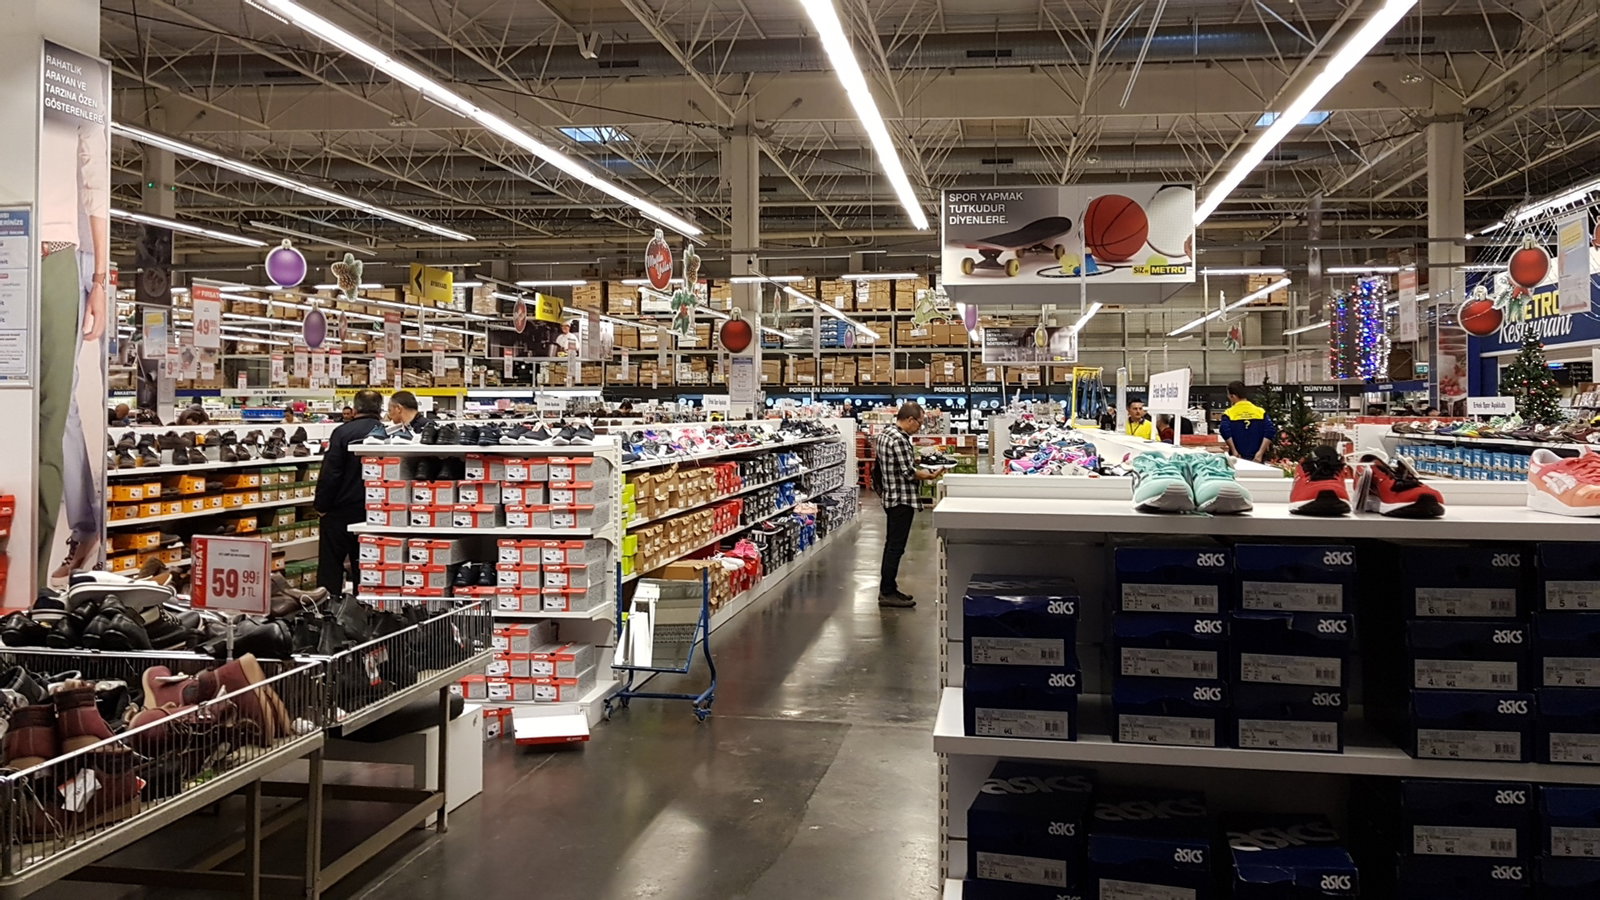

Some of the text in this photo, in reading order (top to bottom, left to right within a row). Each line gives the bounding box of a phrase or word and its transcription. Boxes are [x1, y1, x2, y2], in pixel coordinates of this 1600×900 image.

[46, 54, 82, 76] RAHATLIK
[45, 69, 87, 92] ARAYAN VE
[45, 83, 98, 108] TARZINA ÖZEN
[949, 192, 1023, 202] SPOR YAPMAK
[949, 204, 1005, 214] TUTKUDUR
[949, 213, 1008, 225] DİYENLERE.
[197, 319, 210, 335] 49
[1196, 553, 1225, 567] asics
[1323, 552, 1353, 566] asics
[1491, 553, 1520, 567] asics
[212, 568, 255, 598] 59 99
[1047, 601, 1074, 614] asics
[1194, 620, 1222, 634] asics
[1317, 620, 1347, 633] asics
[1492, 630, 1522, 644] asics
[1048, 674, 1076, 688] asics
[1193, 686, 1221, 701] asics
[1312, 692, 1341, 707] asics
[1497, 700, 1528, 714] asics
[1495, 790, 1526, 804] asics
[1048, 821, 1076, 837] asics
[1174, 848, 1203, 863] asics
[1491, 865, 1522, 880] asics
[1320, 875, 1351, 890] asics
